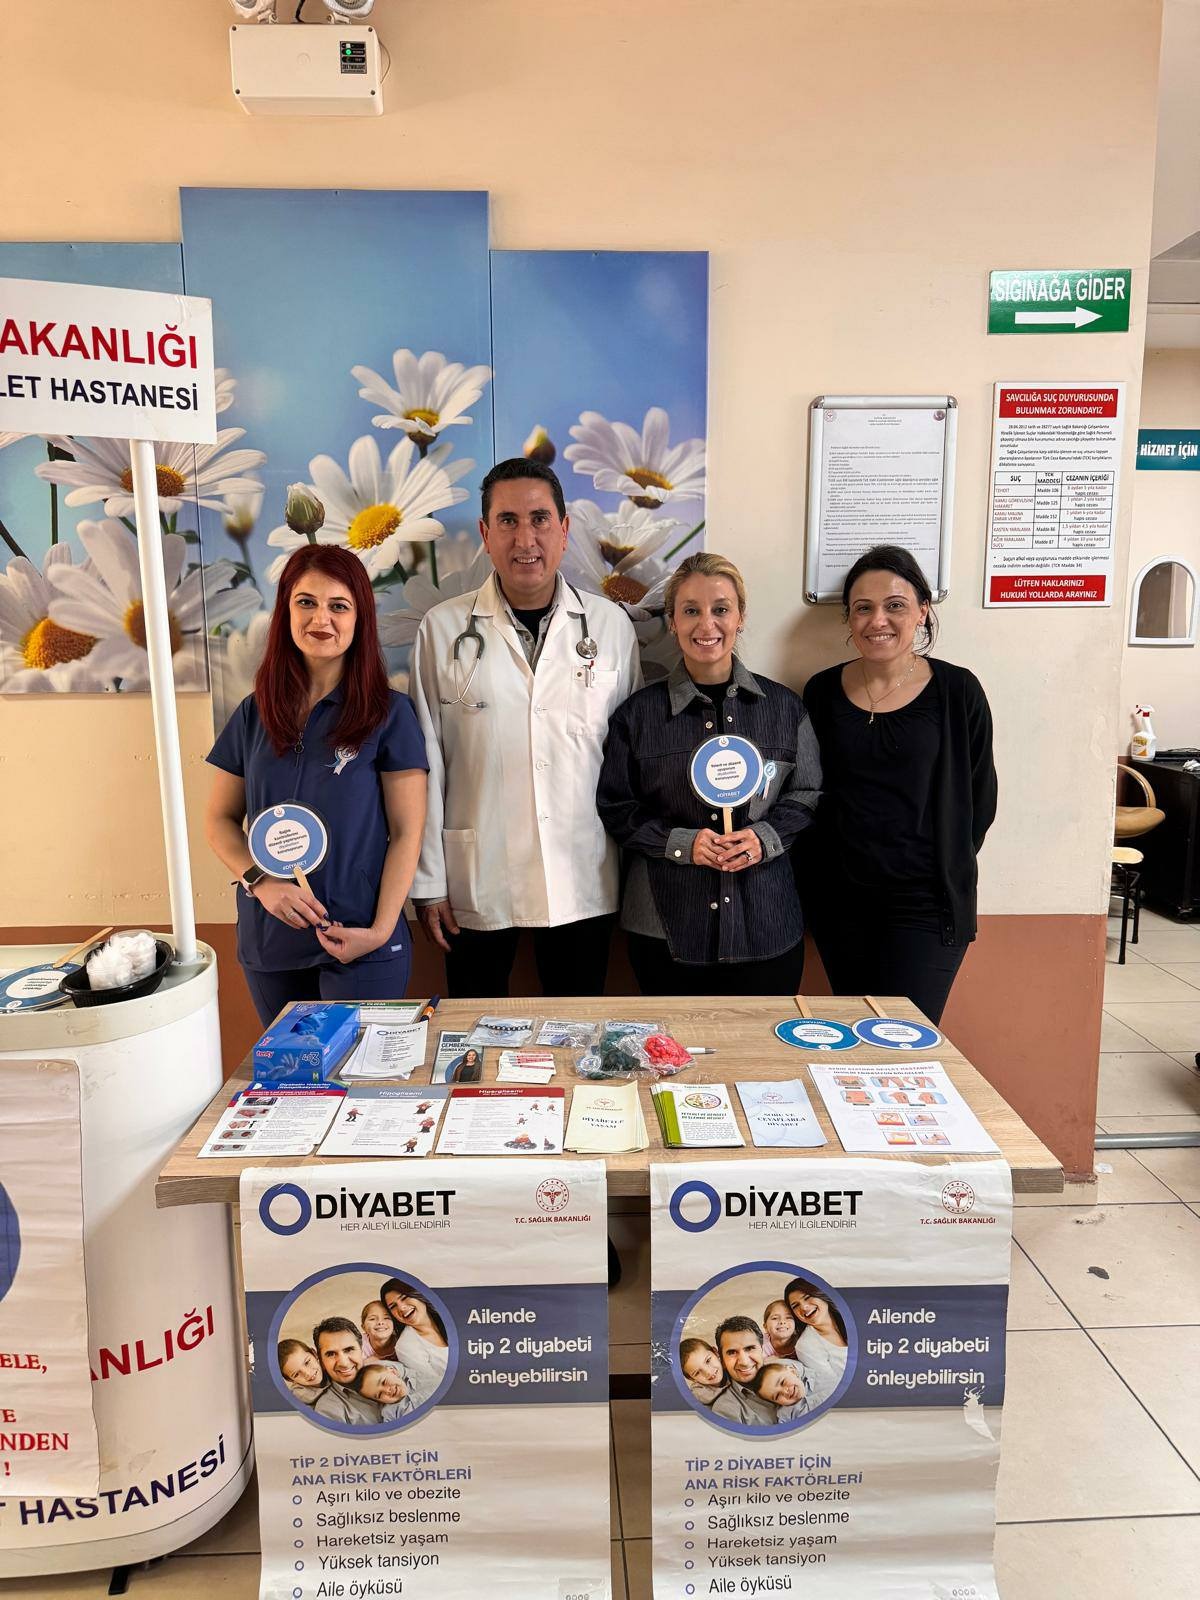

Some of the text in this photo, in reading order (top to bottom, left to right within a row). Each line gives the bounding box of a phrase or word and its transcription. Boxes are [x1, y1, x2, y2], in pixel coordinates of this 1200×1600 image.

[993, 273, 1125, 301] SIĞINAĞA GİDER
[0, 318, 197, 369] AKANLIĞI
[50, 377, 198, 411] HASTANESİ
[1006, 392, 1114, 403] SAVCILIĞA SUÇ DUYURUSUNDA
[1015, 406, 1103, 415] BULUNMAK ZORUNDAYIZ
[1140, 441, 1198, 460] HİZMET İÇİN
[1010, 475, 1022, 483] SUÇ
[1090, 473, 1110, 482] İÇERİĞİ
[1014, 578, 1085, 588] LÜTFEN HAKLARINIZI
[1000, 590, 1098, 599] HUKUKİ YOLLARDA ARAYINIZ
[315, 1187, 456, 1220] DİYABET
[725, 1185, 863, 1217] DİYABET
[340, 1219, 451, 1232] HER AİLEYİ İLGİLENDİRİR
[515, 1214, 591, 1224] T.C. SAĞLIK BAKANLIĞI
[748, 1218, 857, 1230] HER AİLEYİ İLGİLENDİRİR
[920, 1215, 996, 1225] T.C. SAĞLIK BAKANLIĞI
[467, 1308, 537, 1324] Ailende
[867, 1308, 936, 1324] Ailende
[467, 1336, 592, 1359] tip 2 diyabeti
[866, 1336, 990, 1359] tip 2 diyabeti
[0, 1353, 48, 1374] ELE,
[469, 1368, 588, 1387] önleyebilirsin
[866, 1369, 985, 1389] önleyebilirsin
[0, 1433, 70, 1451] NDEN
[290, 1449, 439, 1468] TİP 2 DİYABET İÇİN
[685, 1454, 831, 1471] TİP 2 DİYABET İÇİN
[20, 1433, 226, 1525] HASTANESİ
[292, 1465, 472, 1486] ANA RİSK FAKTÖRLERİ
[685, 1472, 863, 1490] ANA RİSK FAKTÖRLERİ
[316, 1486, 461, 1507] Aşırı kilo ve obezite
[707, 1489, 850, 1509] Aşırı kilo ve obezite
[316, 1509, 461, 1529] Sağlıksız beslenme
[708, 1511, 850, 1531] Sağlıksız beslenme
[317, 1532, 449, 1547] Hareketsiz yaşam
[707, 1534, 838, 1549] Hareketsiz yaşam
[319, 1552, 440, 1570] Yüksek tansiyon
[708, 1553, 827, 1568] Yüksek tansiyon
[316, 1578, 403, 1599] Aile öyküsü
[709, 1575, 792, 1595] Aile öyküsü
